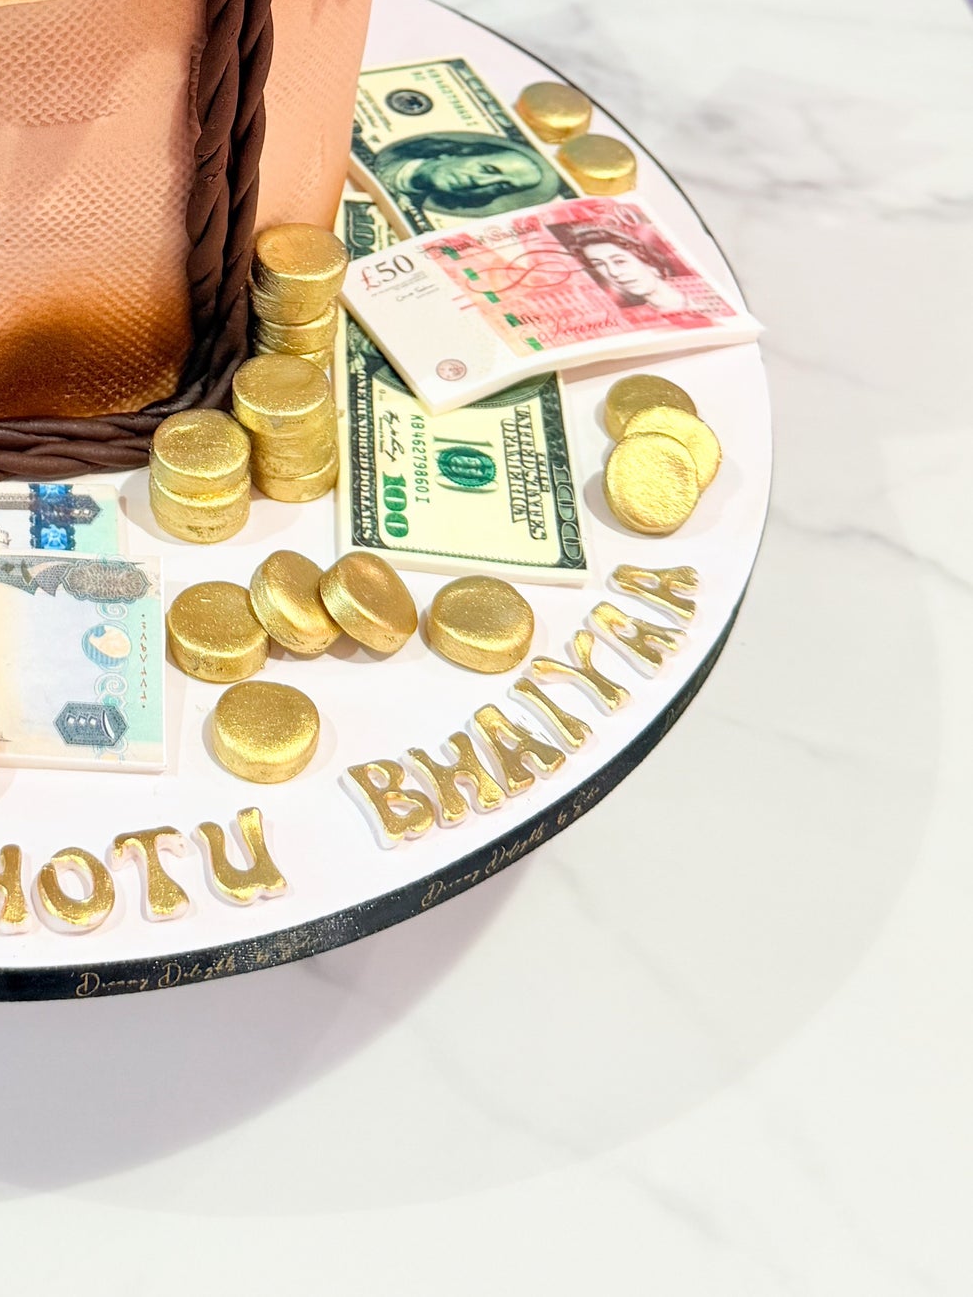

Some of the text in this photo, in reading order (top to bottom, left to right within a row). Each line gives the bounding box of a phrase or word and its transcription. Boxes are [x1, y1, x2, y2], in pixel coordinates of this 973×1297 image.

[361, 255, 415, 292] £50
[356, 369, 373, 540] ONE HUNDRED DOLLARS
[382, 471, 409, 538] 100
[552, 461, 584, 560] 100
